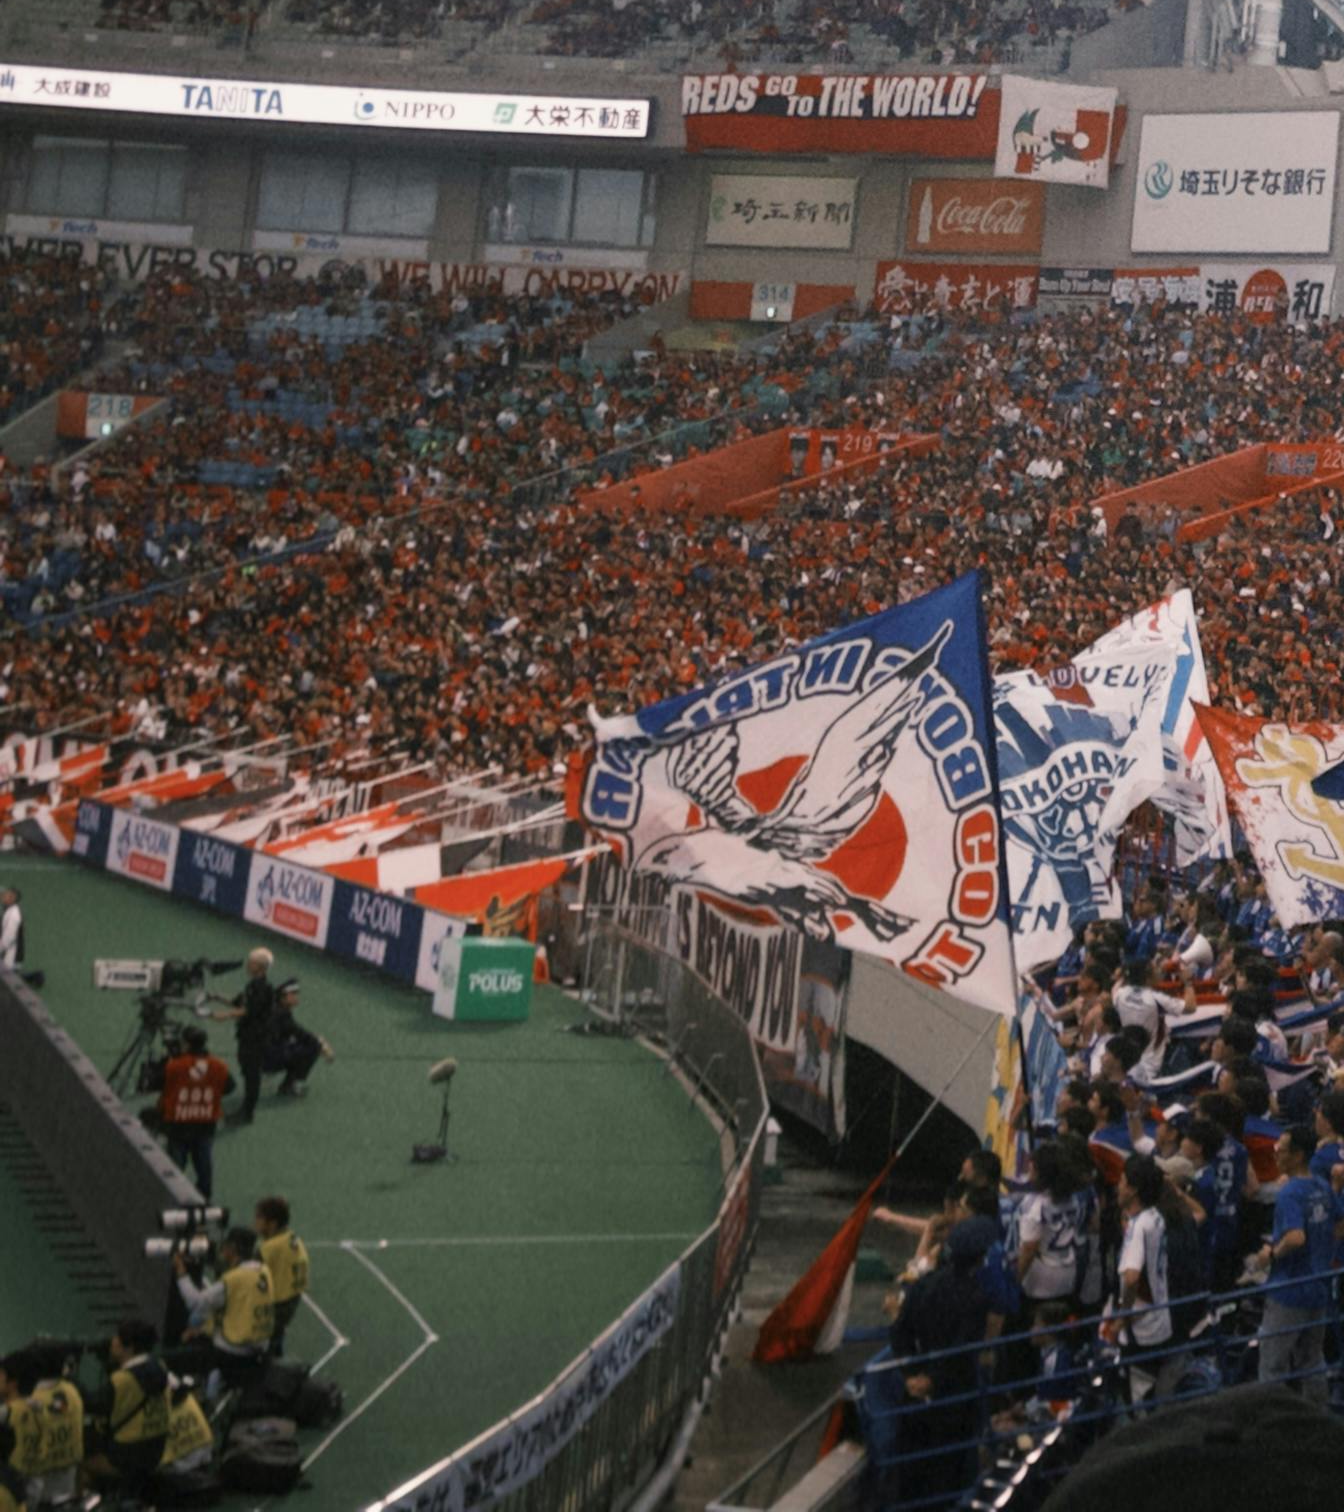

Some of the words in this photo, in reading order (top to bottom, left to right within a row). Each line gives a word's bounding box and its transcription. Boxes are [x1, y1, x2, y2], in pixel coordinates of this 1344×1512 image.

[35, 77, 111, 99] 大成建設
[181, 83, 284, 115] TANITA
[682, 74, 760, 115] REDS
[765, 75, 797, 96] GO
[788, 95, 813, 117] TO
[818, 76, 867, 118] THE
[873, 75, 987, 117] WORLD!
[385, 100, 456, 122] NIPPO
[525, 104, 642, 130] 大栄不動産
[1178, 167, 1326, 196] 埼玉りそな銀行
[379, 262, 430, 291] WE
[639, 271, 681, 301] ON
[1205, 278, 1239, 318] 浦
[1292, 278, 1325, 320] 和
[88, 394, 131, 418] 218
[468, 972, 525, 995] POLUS
